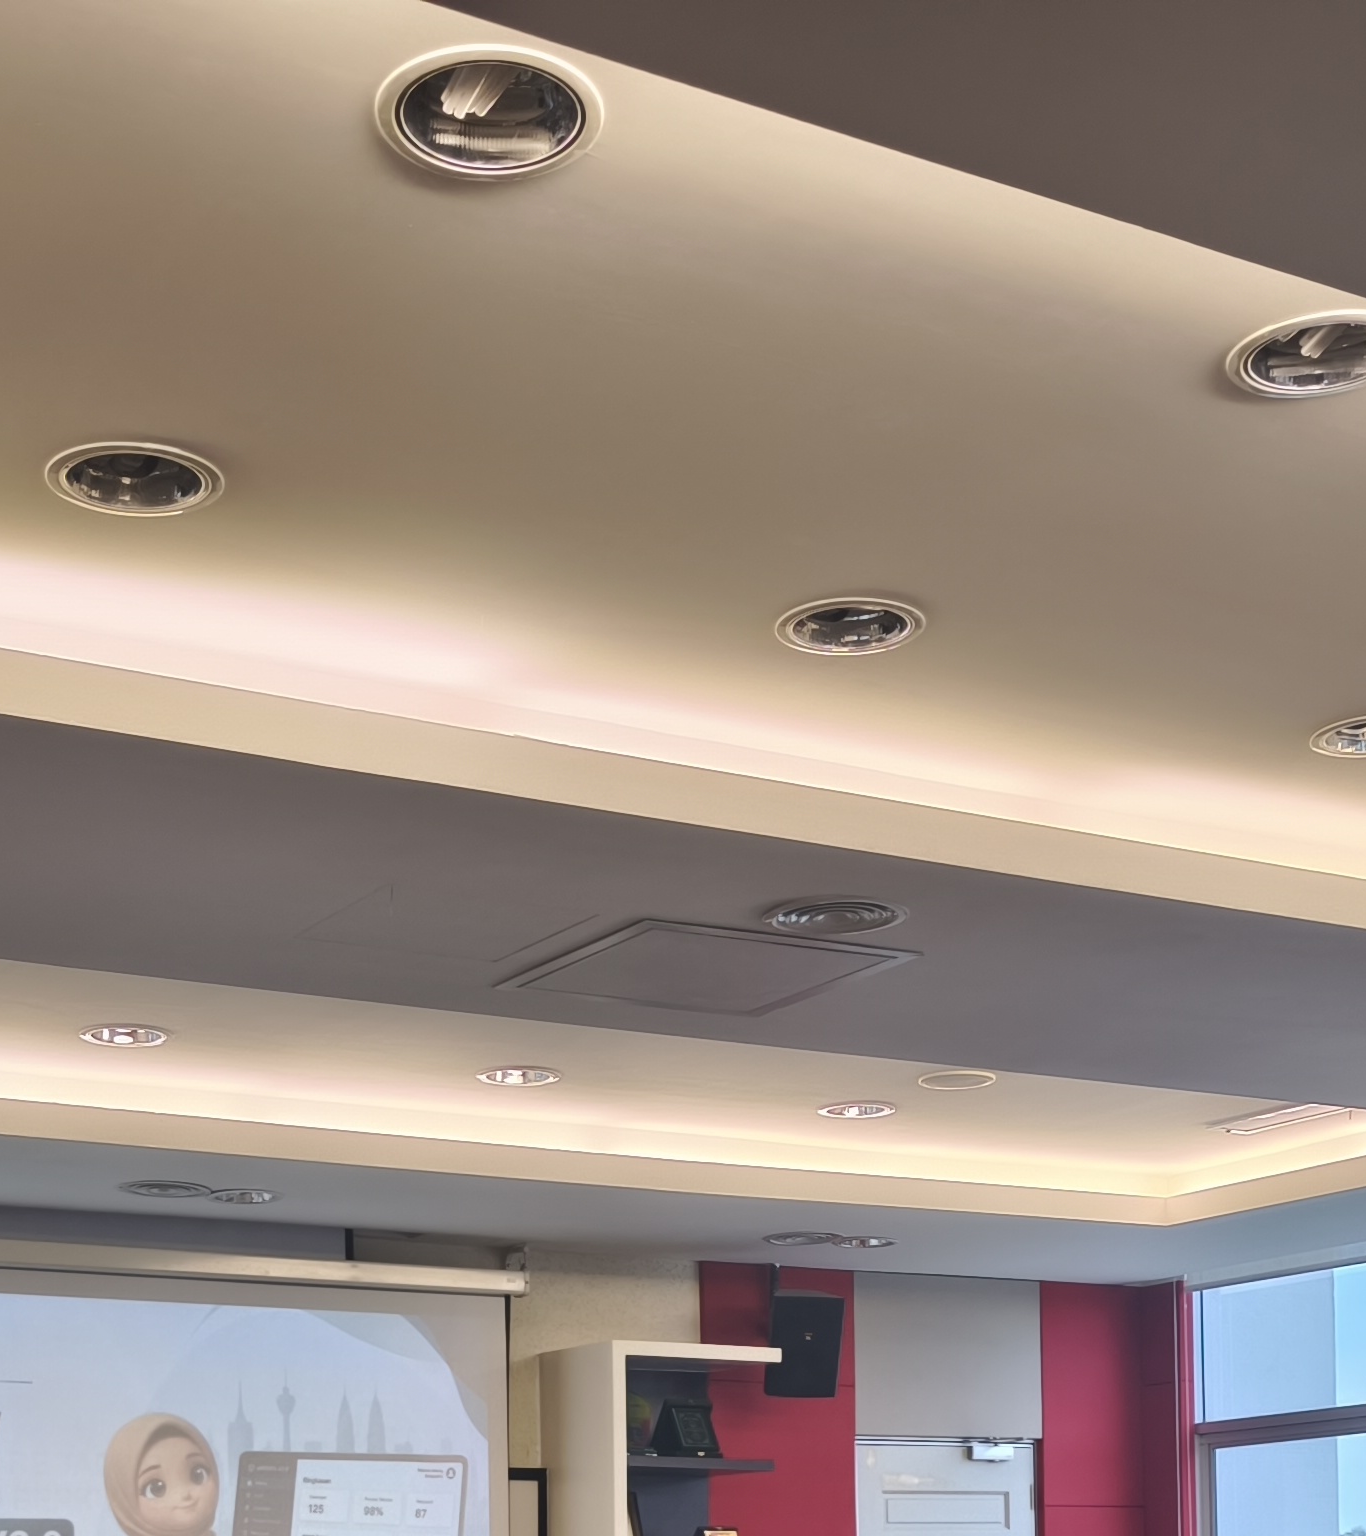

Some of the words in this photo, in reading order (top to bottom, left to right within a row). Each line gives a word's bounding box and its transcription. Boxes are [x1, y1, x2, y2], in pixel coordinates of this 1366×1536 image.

[307, 1503, 325, 1515] 125
[363, 1506, 384, 1517] 98%
[414, 1508, 427, 1519] 87
